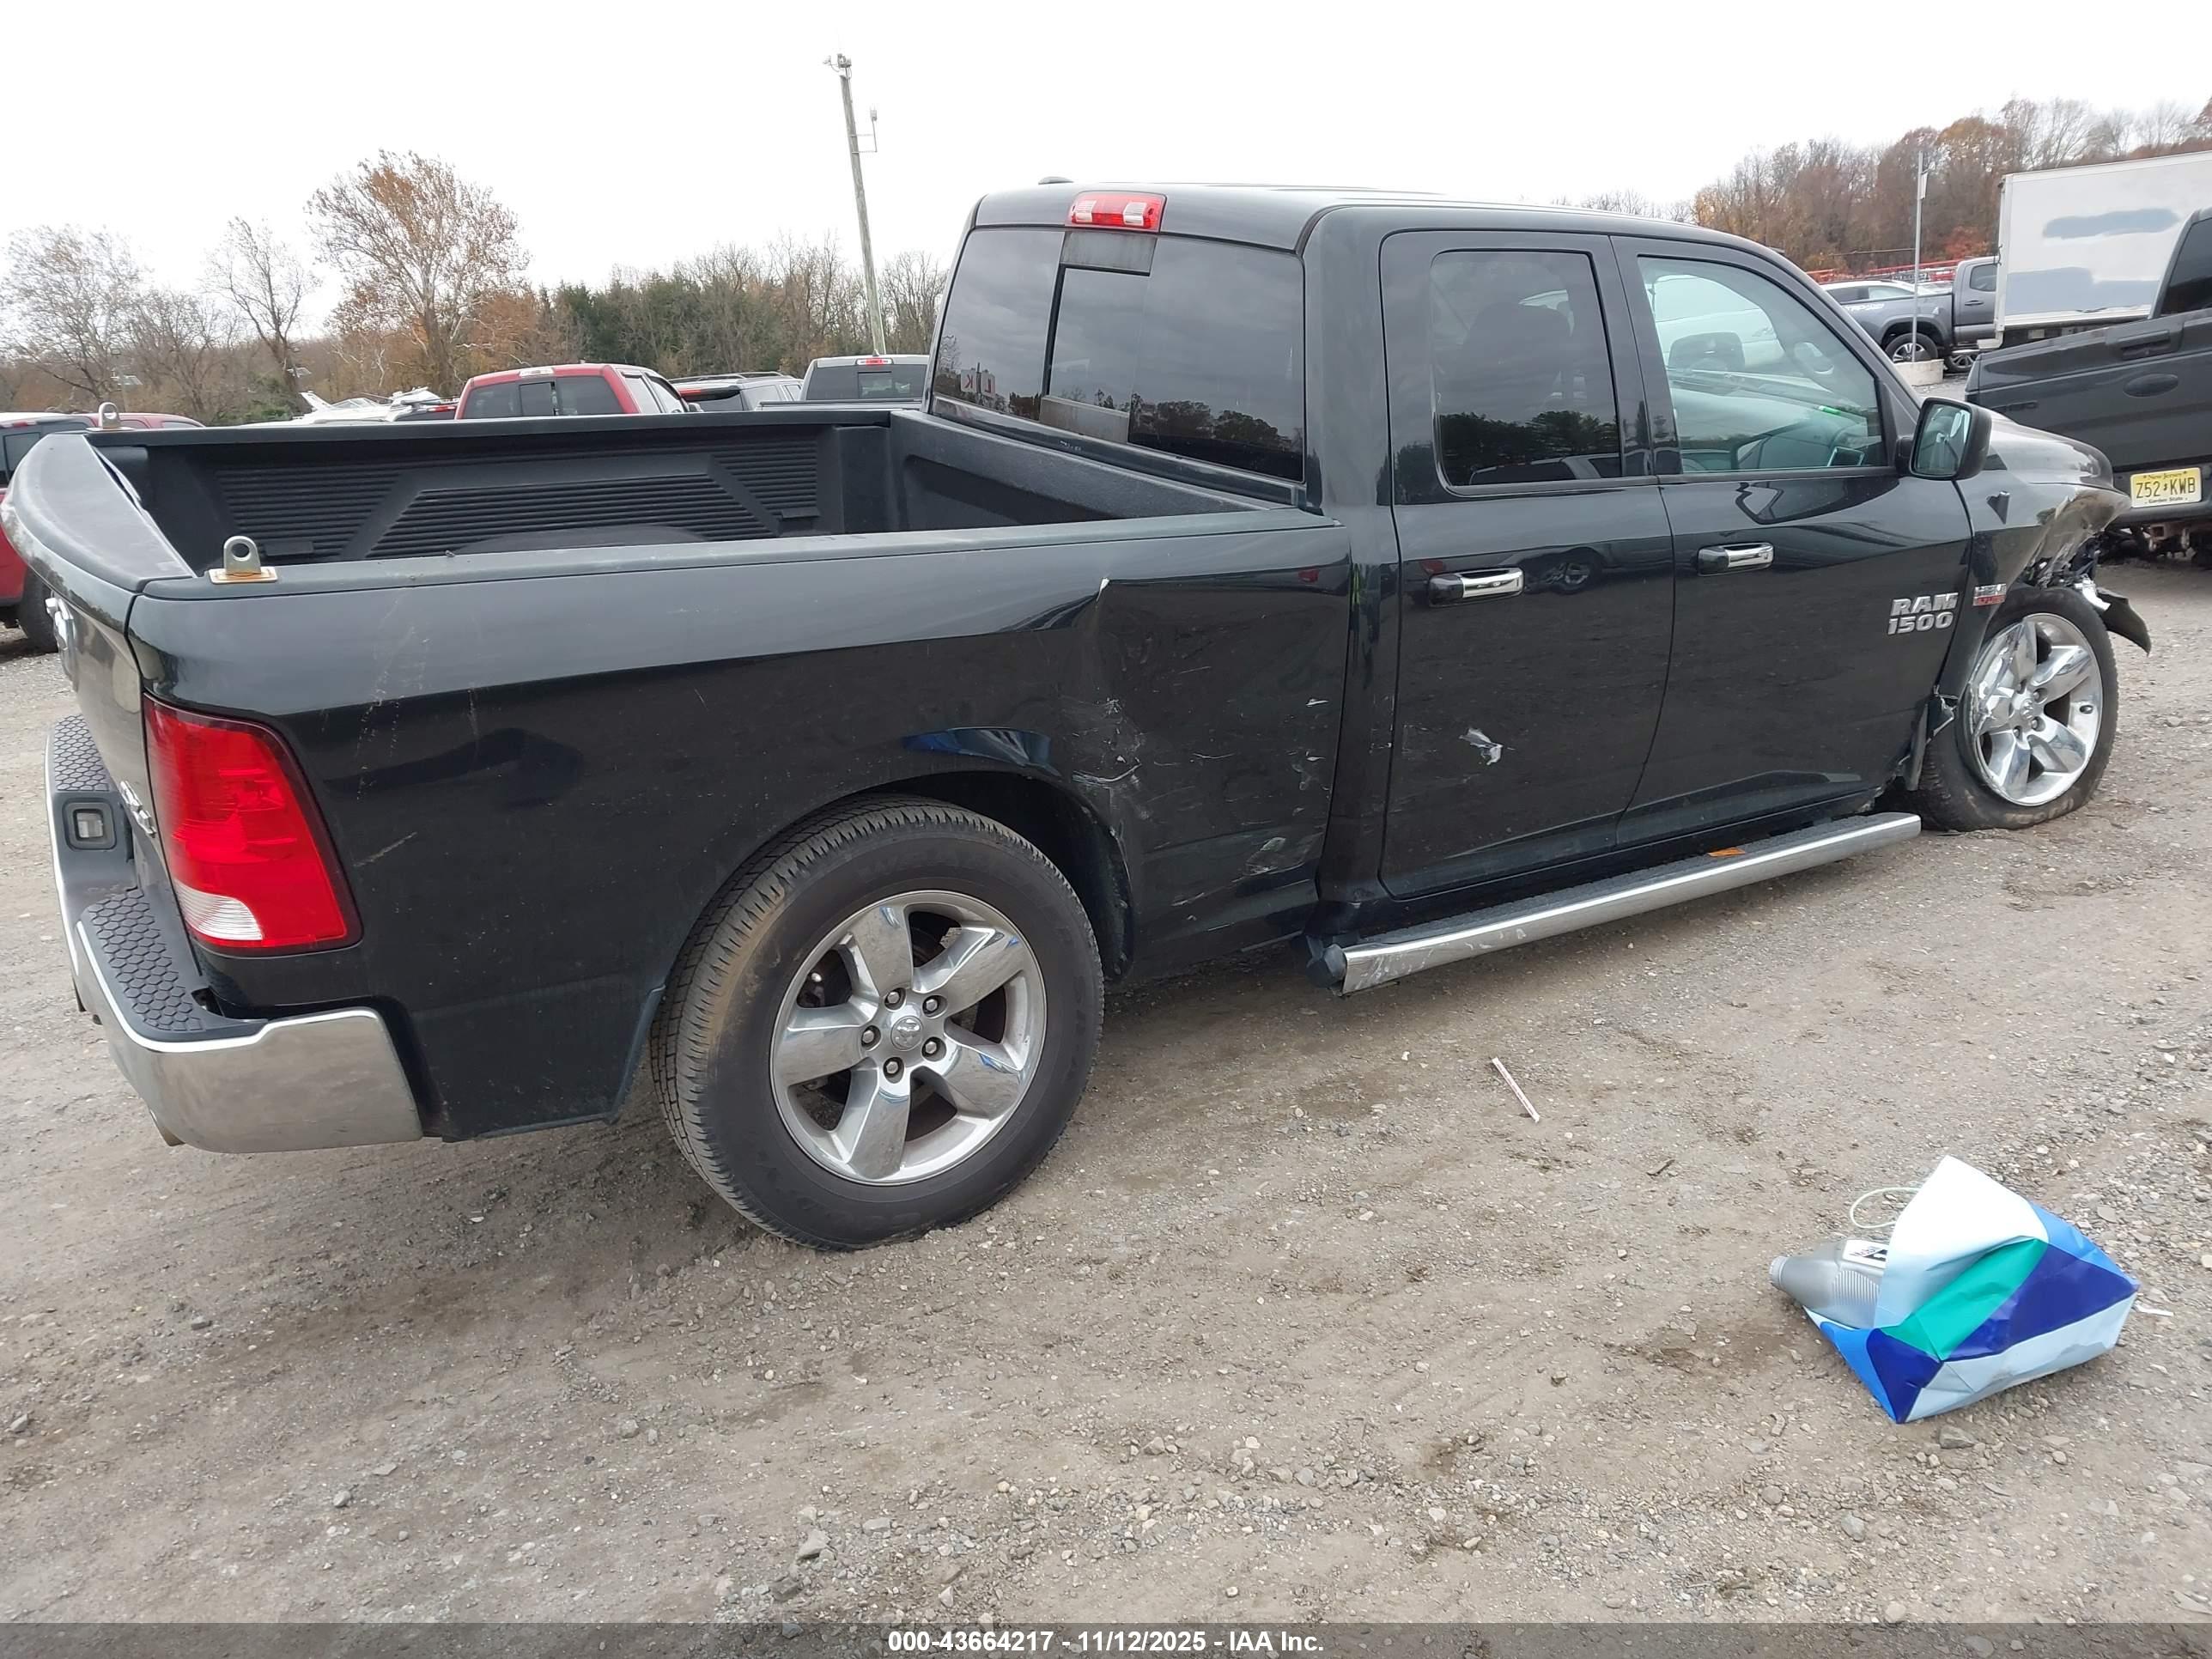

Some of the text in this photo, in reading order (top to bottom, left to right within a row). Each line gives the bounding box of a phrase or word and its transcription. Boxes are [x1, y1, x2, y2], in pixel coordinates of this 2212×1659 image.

[2136, 477, 2195, 498] Z52 KWB
[1891, 592, 1959, 616] RAM
[1887, 611, 1954, 635] 1500
